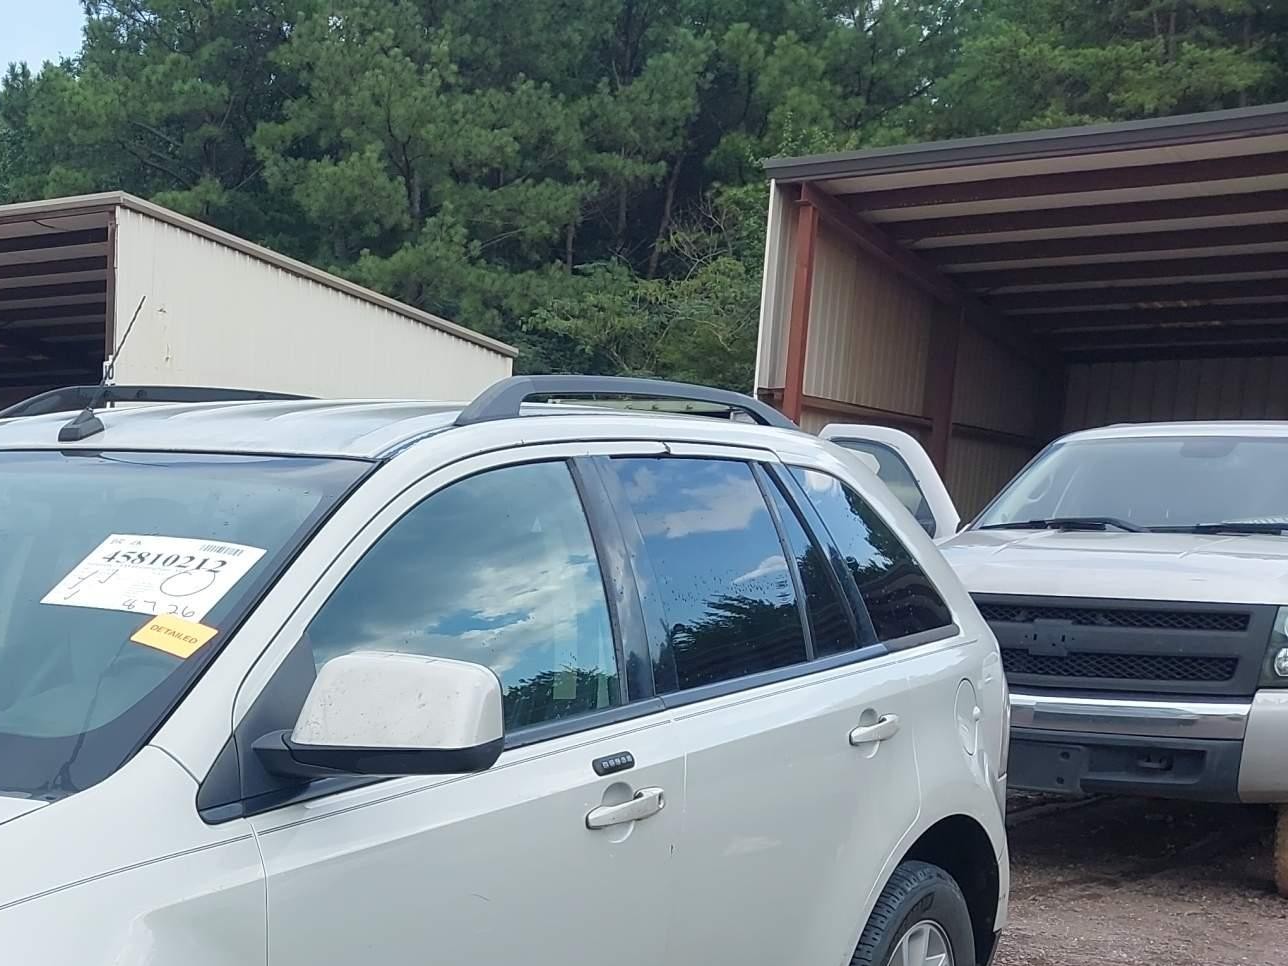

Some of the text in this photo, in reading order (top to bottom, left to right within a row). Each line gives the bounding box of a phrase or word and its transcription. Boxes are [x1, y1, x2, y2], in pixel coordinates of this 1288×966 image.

[102, 550, 227, 573] 45810212
[166, 604, 195, 618] 26
[149, 623, 199, 645] DETAILED
